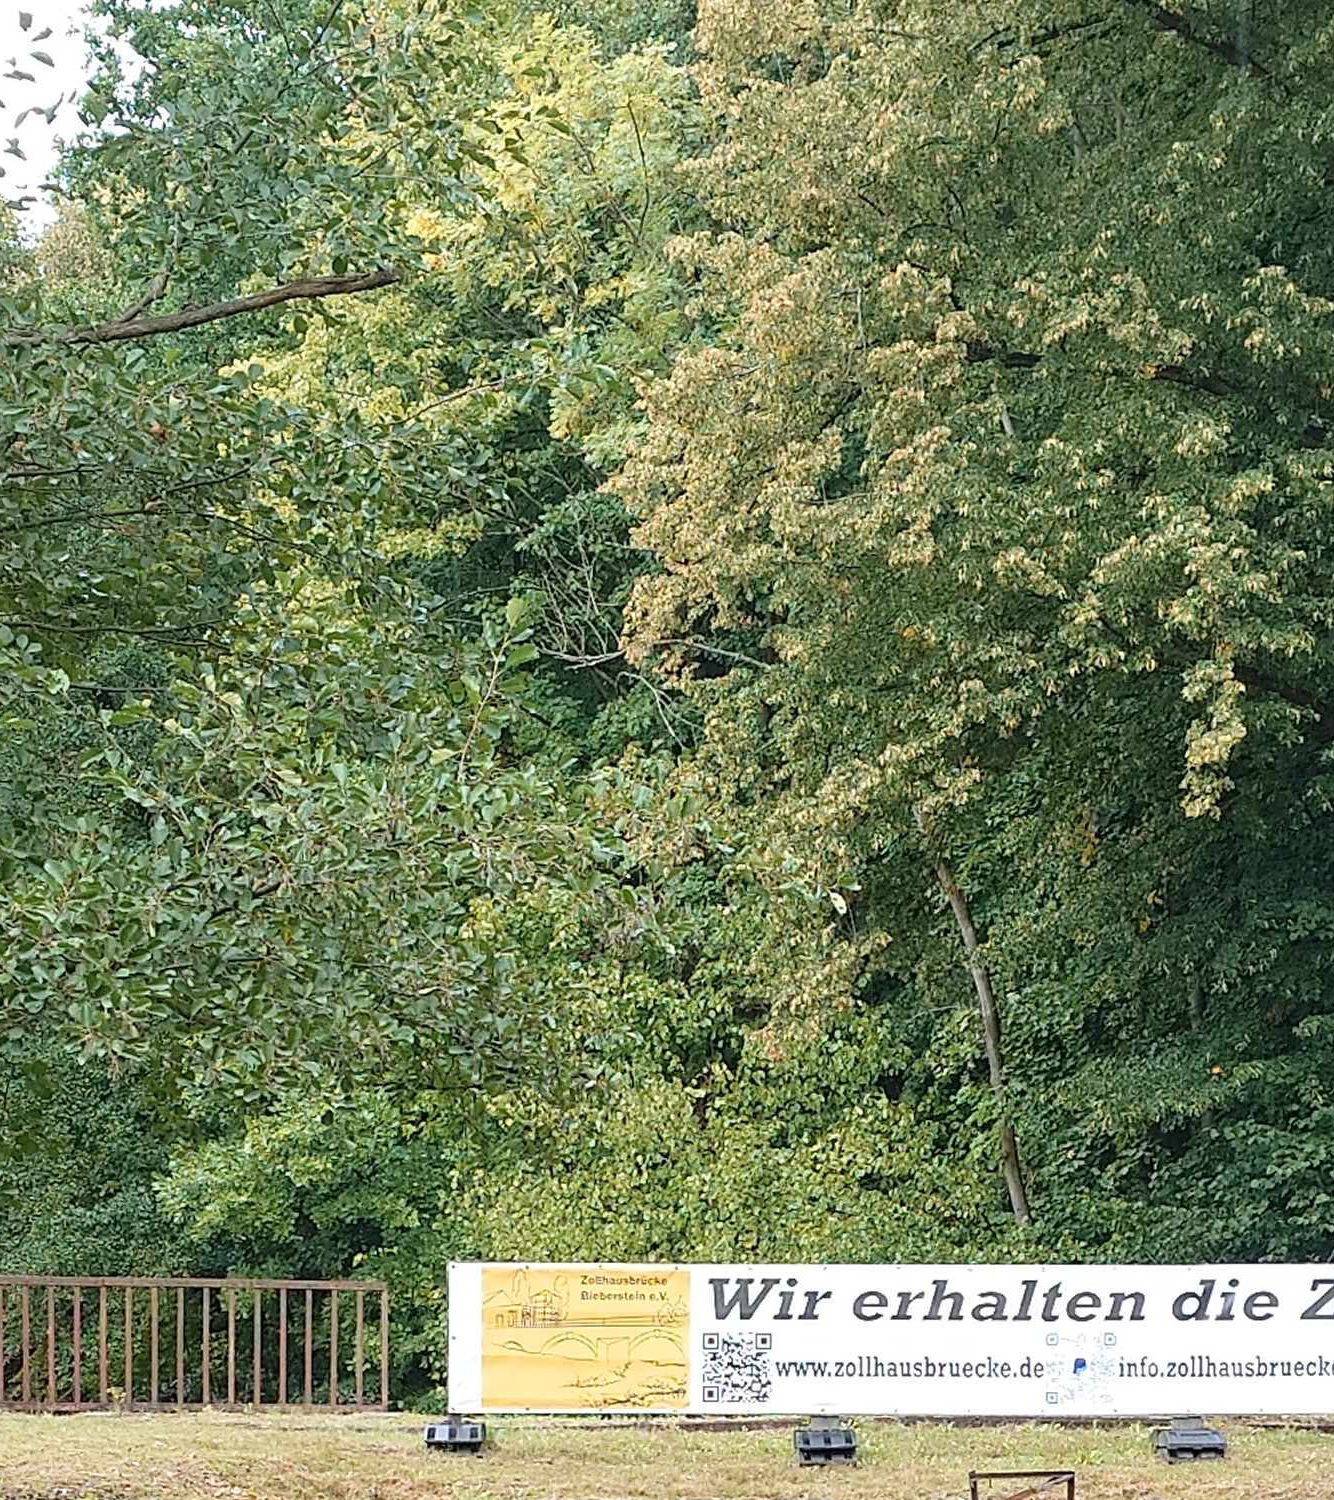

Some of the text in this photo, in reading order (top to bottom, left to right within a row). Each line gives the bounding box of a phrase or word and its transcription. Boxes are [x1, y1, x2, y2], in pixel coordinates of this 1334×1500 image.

[580, 1275, 668, 1285] Zollhausbrücke
[581, 1290, 669, 1301] Bieberstein e.V.
[709, 1278, 832, 1321] Wir
[853, 1279, 1145, 1322] erhalten
[1173, 1279, 1279, 1321] die
[776, 1356, 1044, 1378] www.zollhausbruecke.de
